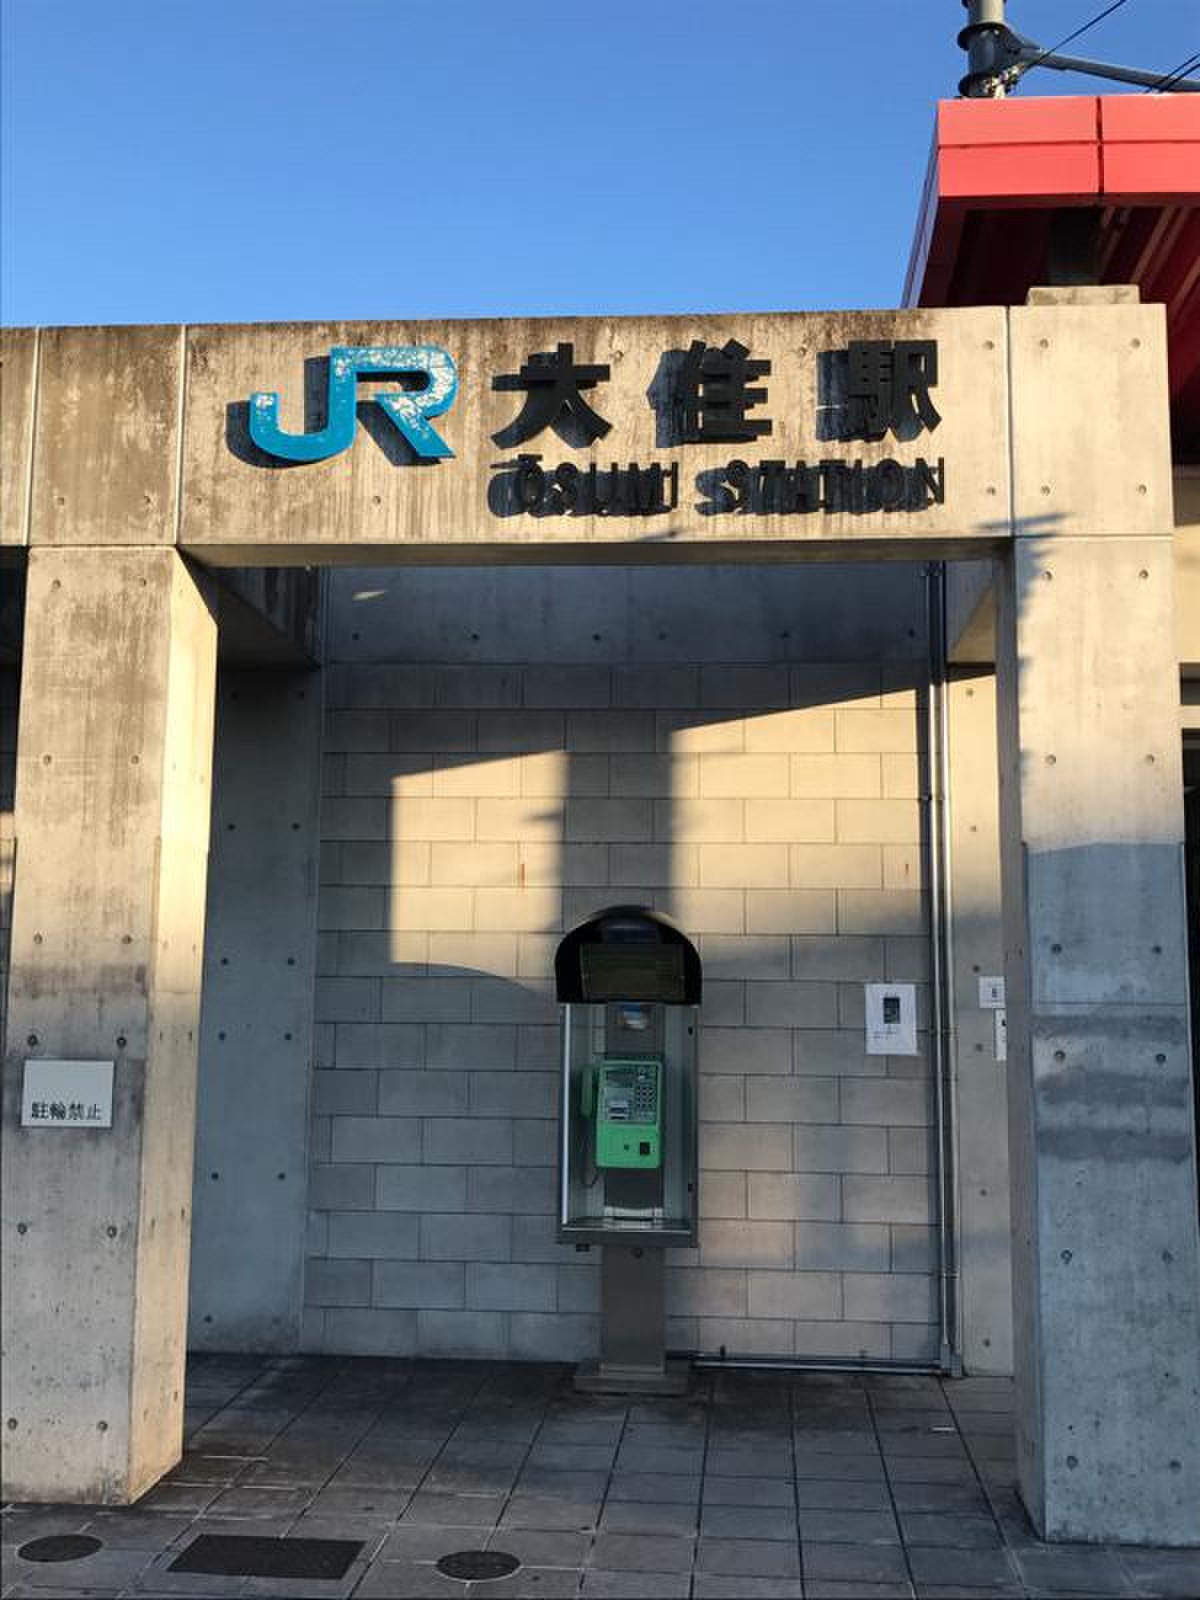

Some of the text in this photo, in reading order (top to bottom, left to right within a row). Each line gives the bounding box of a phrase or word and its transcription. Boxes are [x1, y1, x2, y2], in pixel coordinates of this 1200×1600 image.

[249, 345, 457, 464] JR
[492, 338, 943, 448] 大住駅
